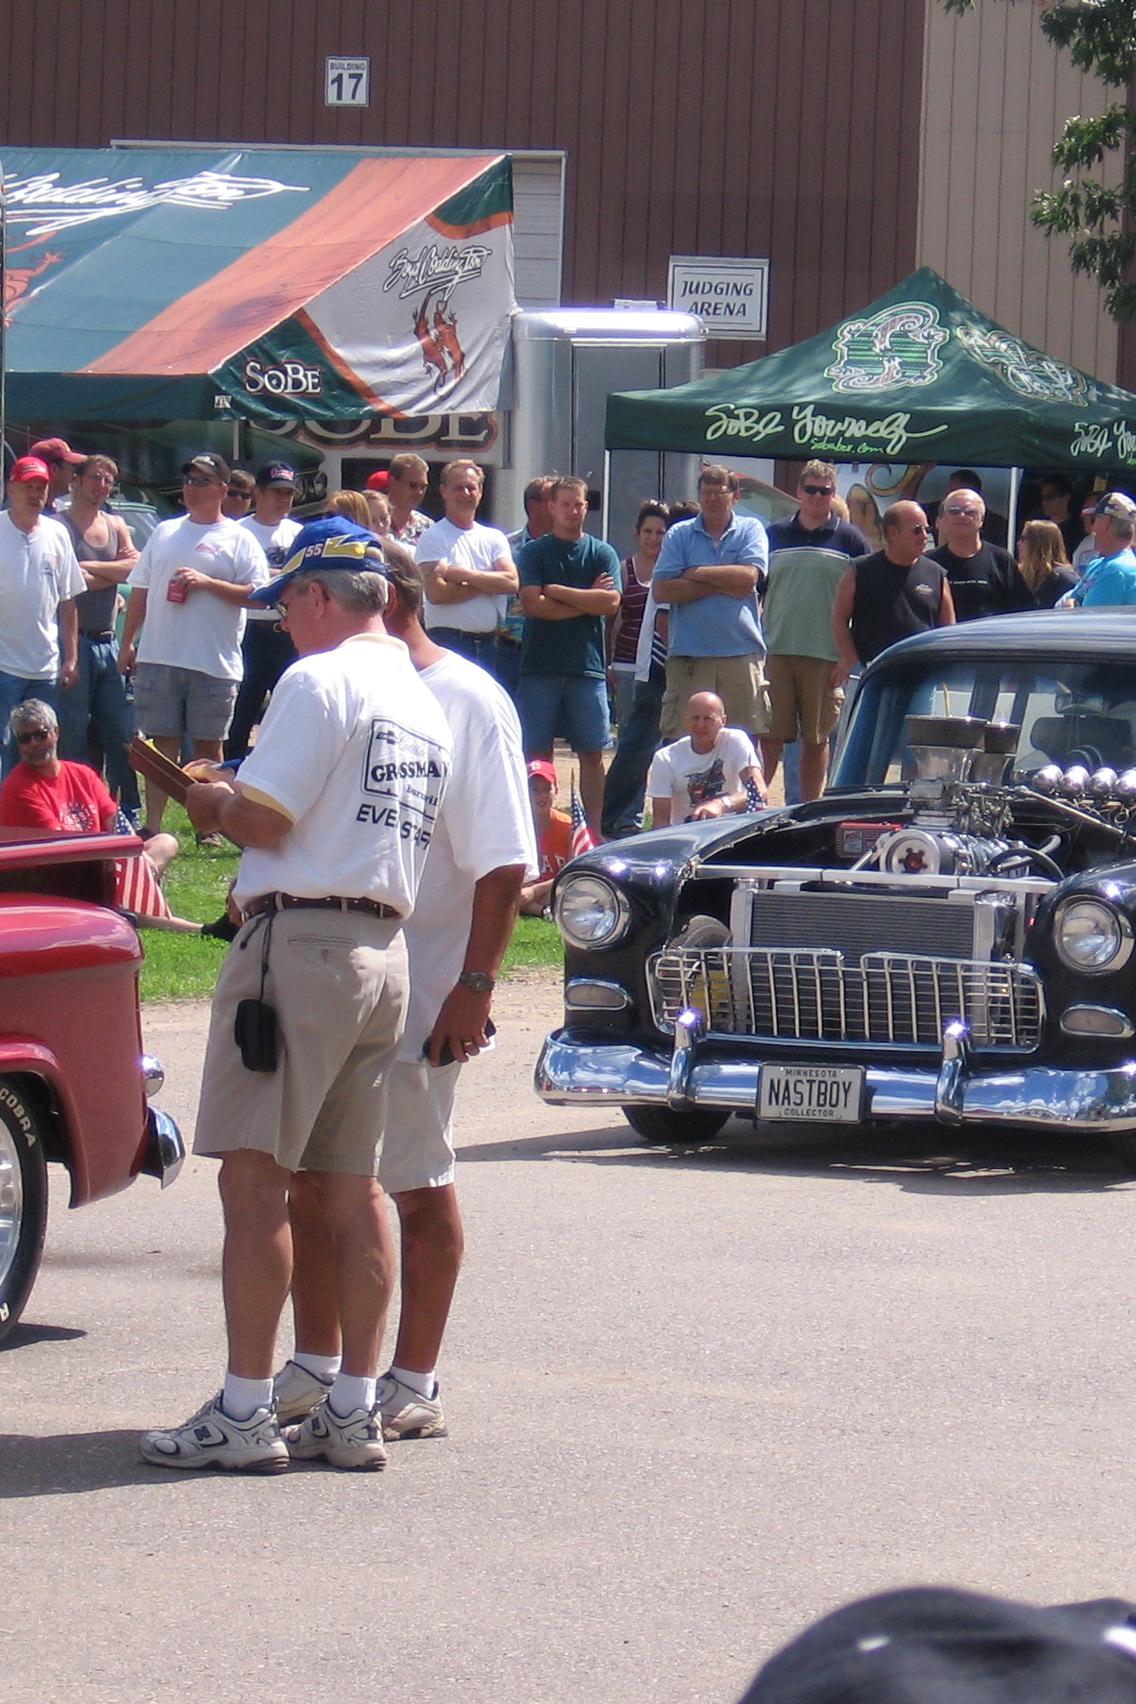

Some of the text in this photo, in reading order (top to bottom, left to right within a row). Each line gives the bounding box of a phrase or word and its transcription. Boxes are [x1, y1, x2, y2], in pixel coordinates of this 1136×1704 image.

[330, 73, 363, 100] 17
[680, 280, 755, 297] JUDGING
[688, 301, 747, 317] ARENA
[792, 404, 949, 456] Yourself
[305, 543, 324, 557] 55
[783, 1069, 838, 1078] MINNESOTA
[767, 1078, 852, 1108] NASTBOY
[0, 1086, 37, 1148] COBRA
[783, 1107, 834, 1117] COLLECTOR
